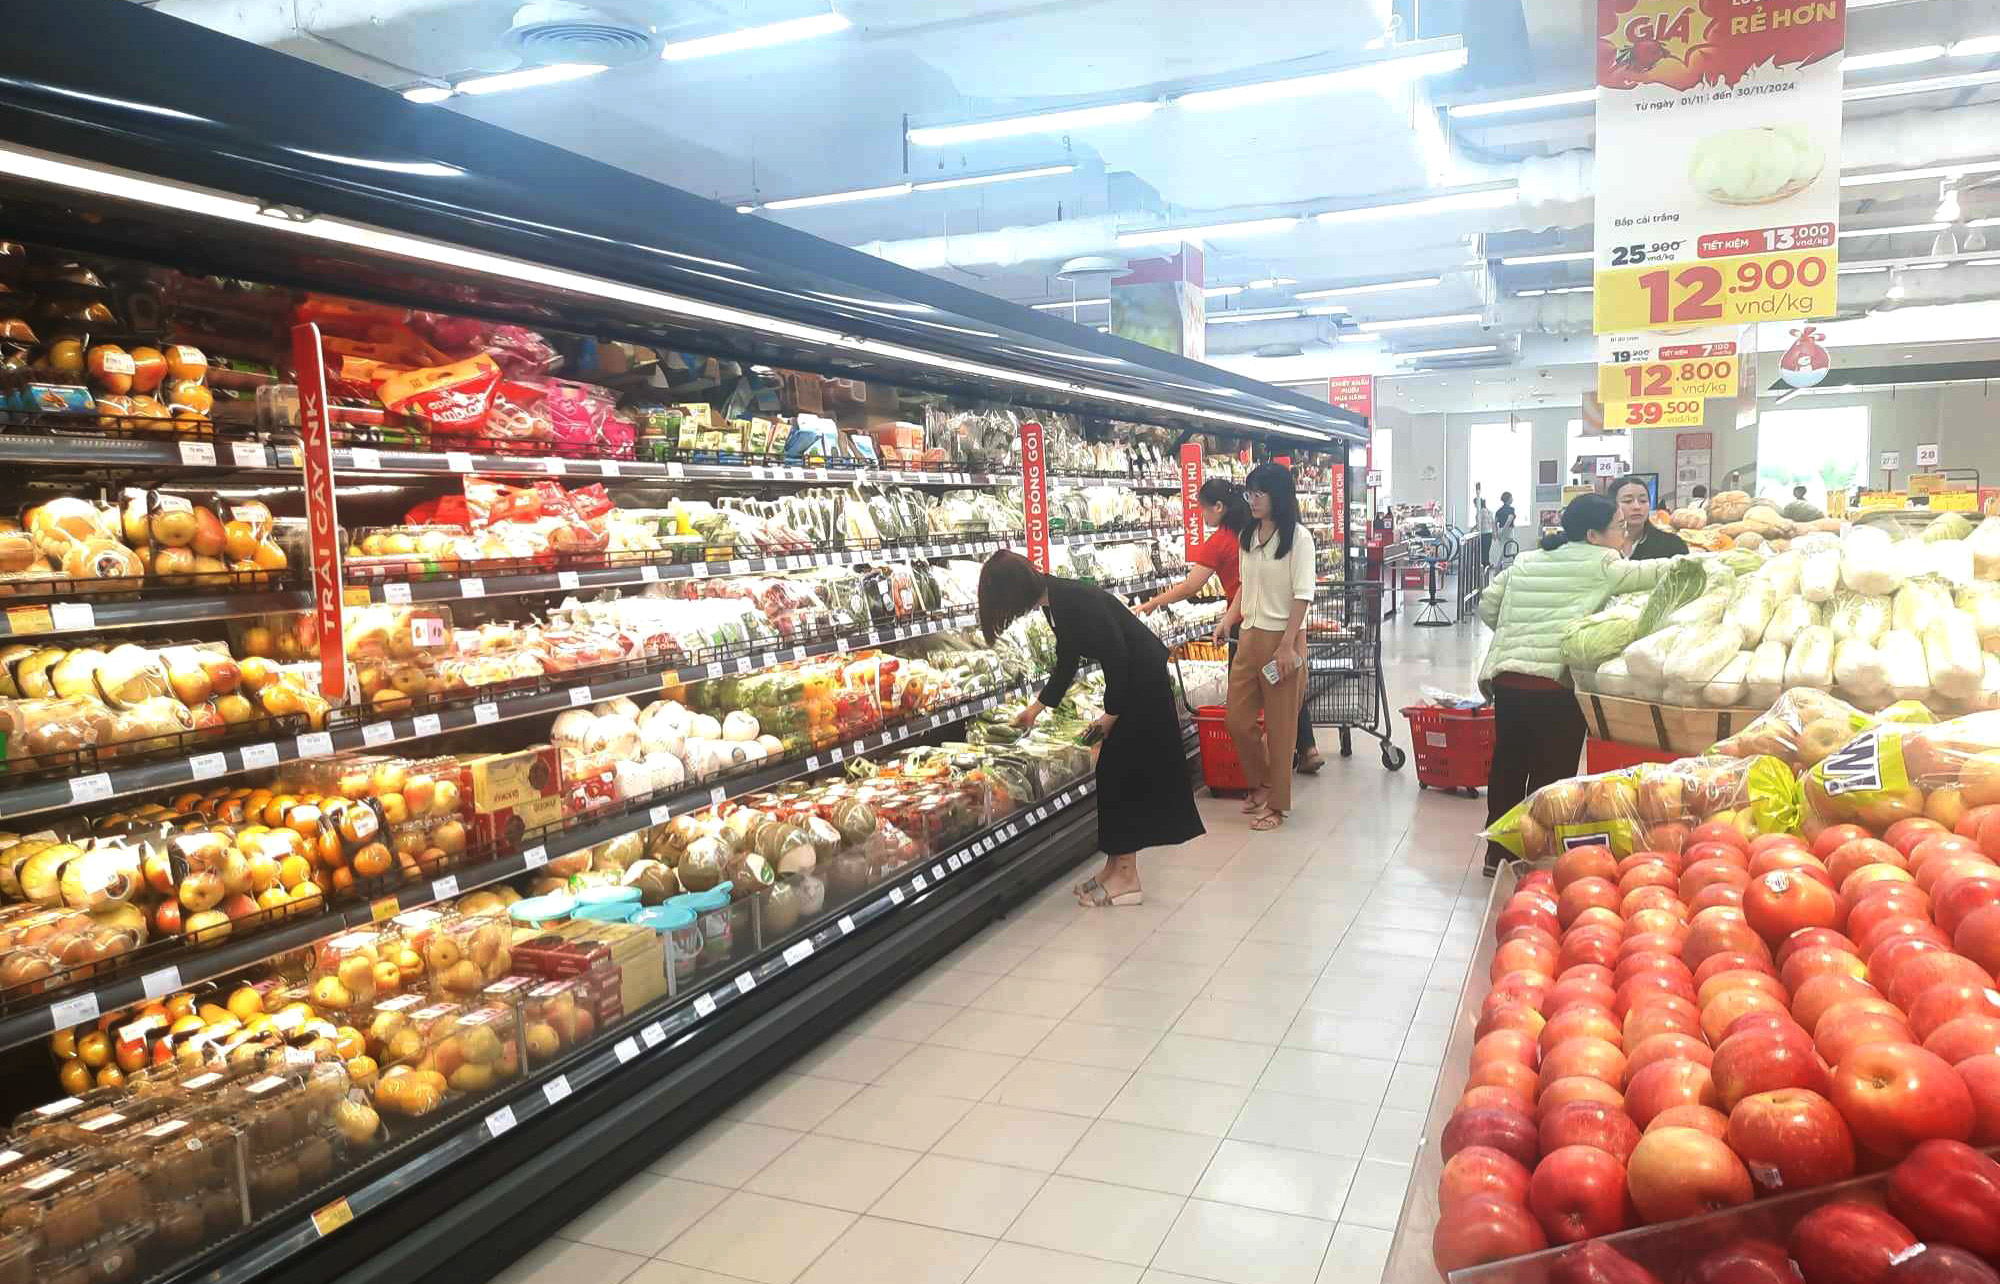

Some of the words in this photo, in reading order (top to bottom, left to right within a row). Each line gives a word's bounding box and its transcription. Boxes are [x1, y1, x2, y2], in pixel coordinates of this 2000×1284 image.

[1731, 6, 1767, 35] RẺ
[1772, 1, 1837, 29] HƠN
[1650, 98, 1675, 112] ngày
[1736, 82, 1795, 97] 30/11/2024
[1703, 238, 1724, 251] TIẾT
[1725, 236, 1749, 250] KIỆM
[1638, 256, 1827, 324] 12.900
[1735, 292, 1814, 316] vnd/kg
[1624, 361, 1731, 397] 12.800
[1681, 382, 1728, 394] vnd/kg
[304, 392, 320, 447] NK
[1625, 401, 1700, 425] 39.500
[1025, 432, 1038, 461] GÓI
[1599, 462, 1612, 472] 26
[1028, 466, 1041, 514] ĐÓNG
[1028, 519, 1043, 542] CỦ
[1032, 545, 1044, 573] AU
